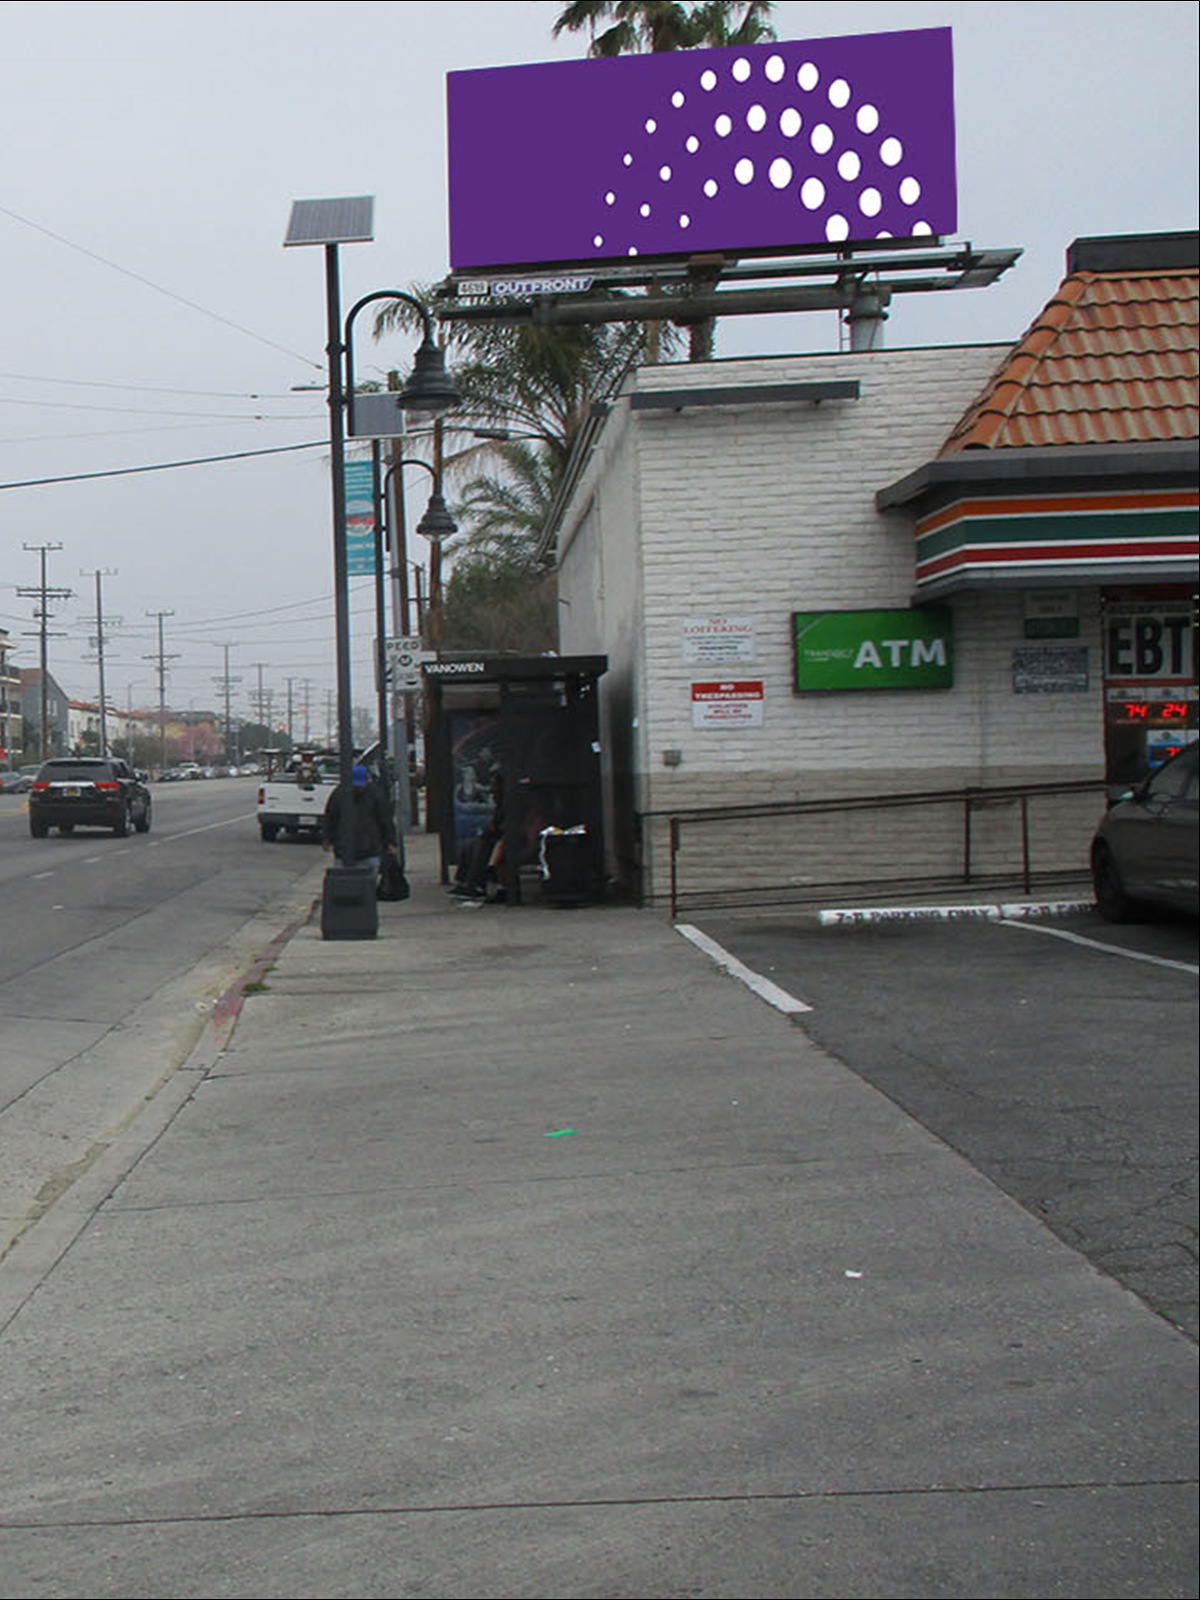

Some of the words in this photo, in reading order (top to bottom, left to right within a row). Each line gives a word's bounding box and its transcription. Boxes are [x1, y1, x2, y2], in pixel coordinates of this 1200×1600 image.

[495, 280, 588, 292] OUTFRONT
[1109, 616, 1190, 675] EBT
[853, 638, 947, 669] ATM
[425, 663, 485, 673] VANOWEN
[1125, 703, 1147, 717] 74
[1161, 703, 1188, 718] 24
[871, 909, 941, 922] PARKING
